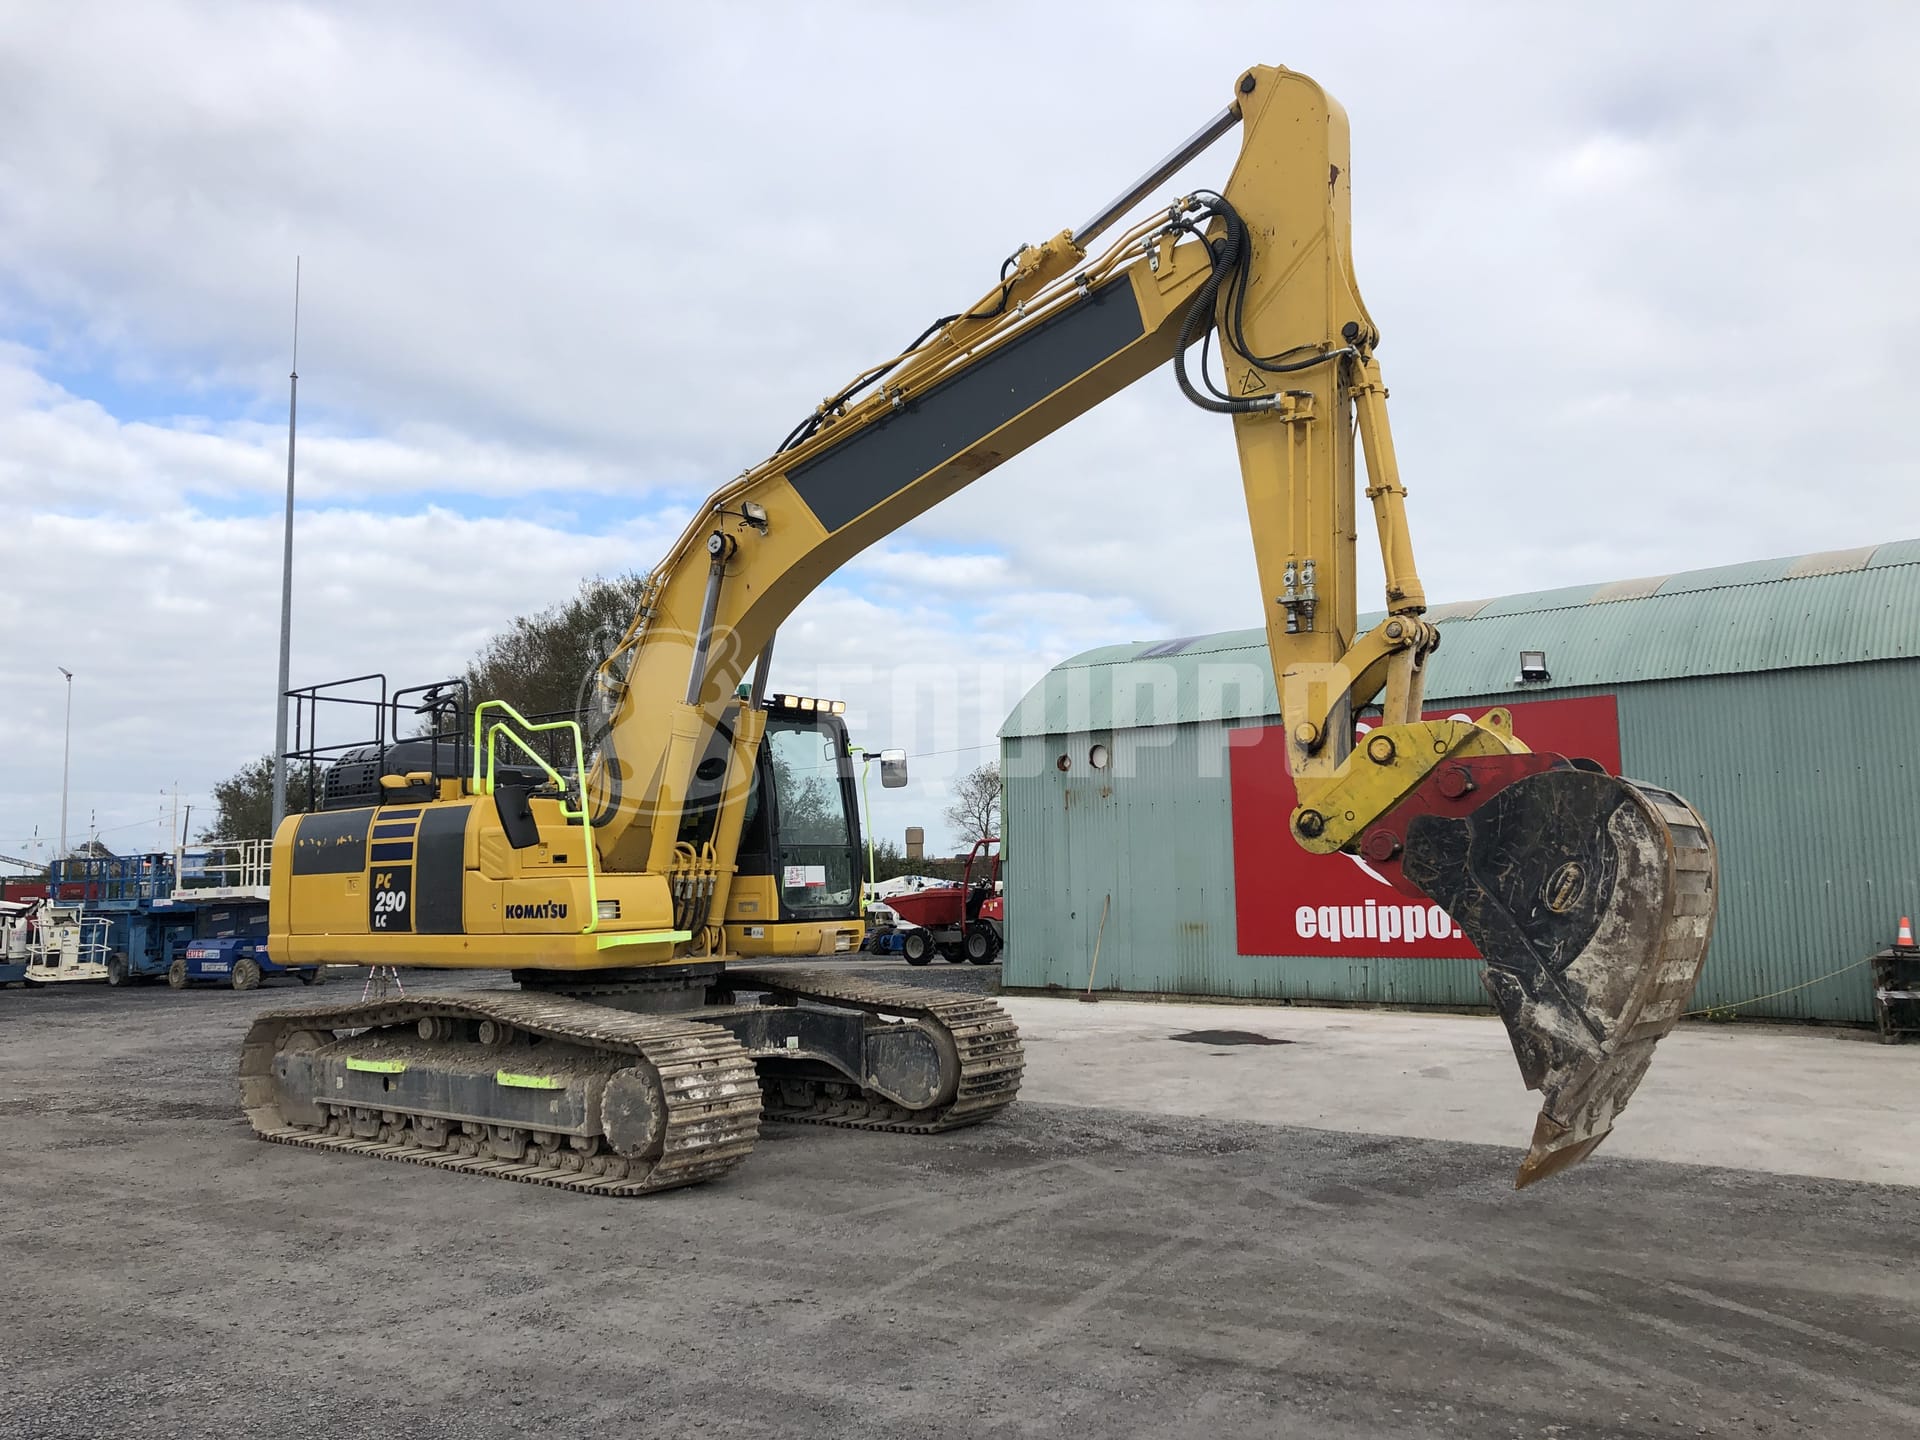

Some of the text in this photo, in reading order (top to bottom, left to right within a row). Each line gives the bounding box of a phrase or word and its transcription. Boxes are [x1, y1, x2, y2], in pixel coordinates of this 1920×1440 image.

[375, 873, 392, 889] PC
[374, 890, 407, 912] 290
[505, 899, 569, 920] KOMATSU
[375, 914, 387, 928] LC
